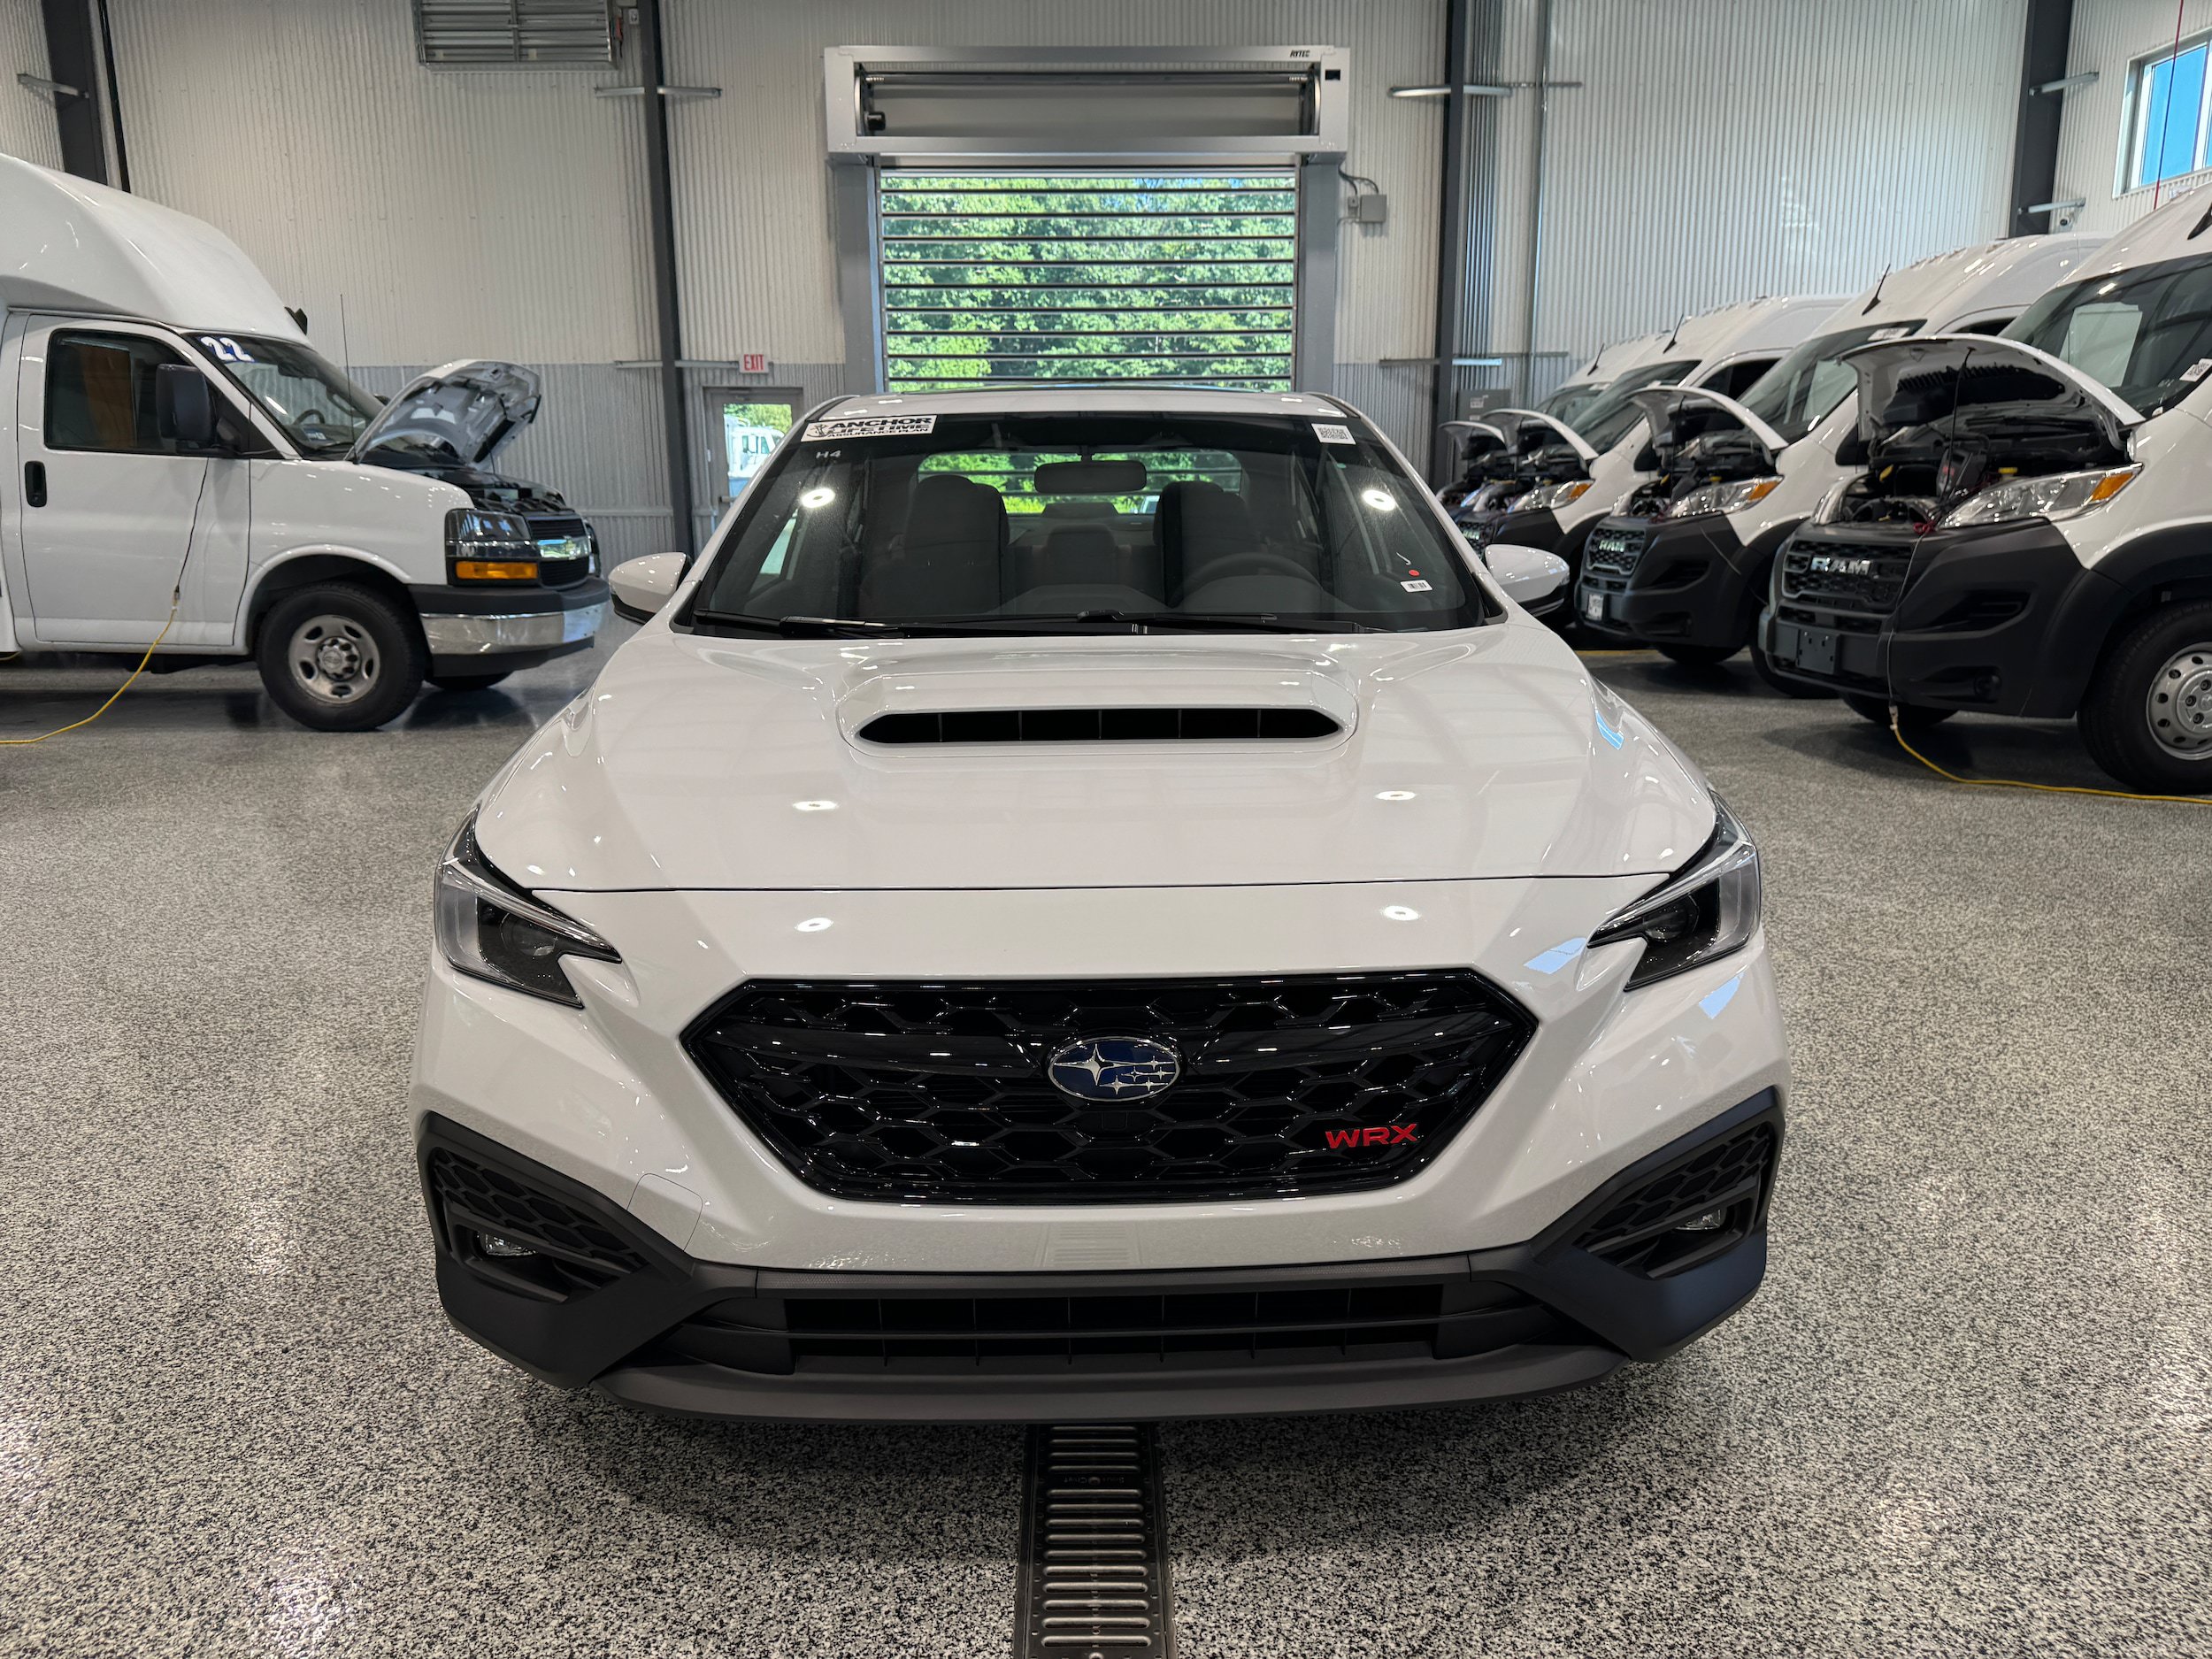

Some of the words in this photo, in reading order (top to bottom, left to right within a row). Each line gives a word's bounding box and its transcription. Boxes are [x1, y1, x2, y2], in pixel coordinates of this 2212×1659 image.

[200, 336, 255, 363] 22
[743, 353, 764, 372] EXIT
[827, 425, 930, 434] LIFETIME
[829, 418, 932, 429] ANCHOR
[1810, 557, 1871, 576] RAM
[1325, 1123, 1418, 1149] WRX
